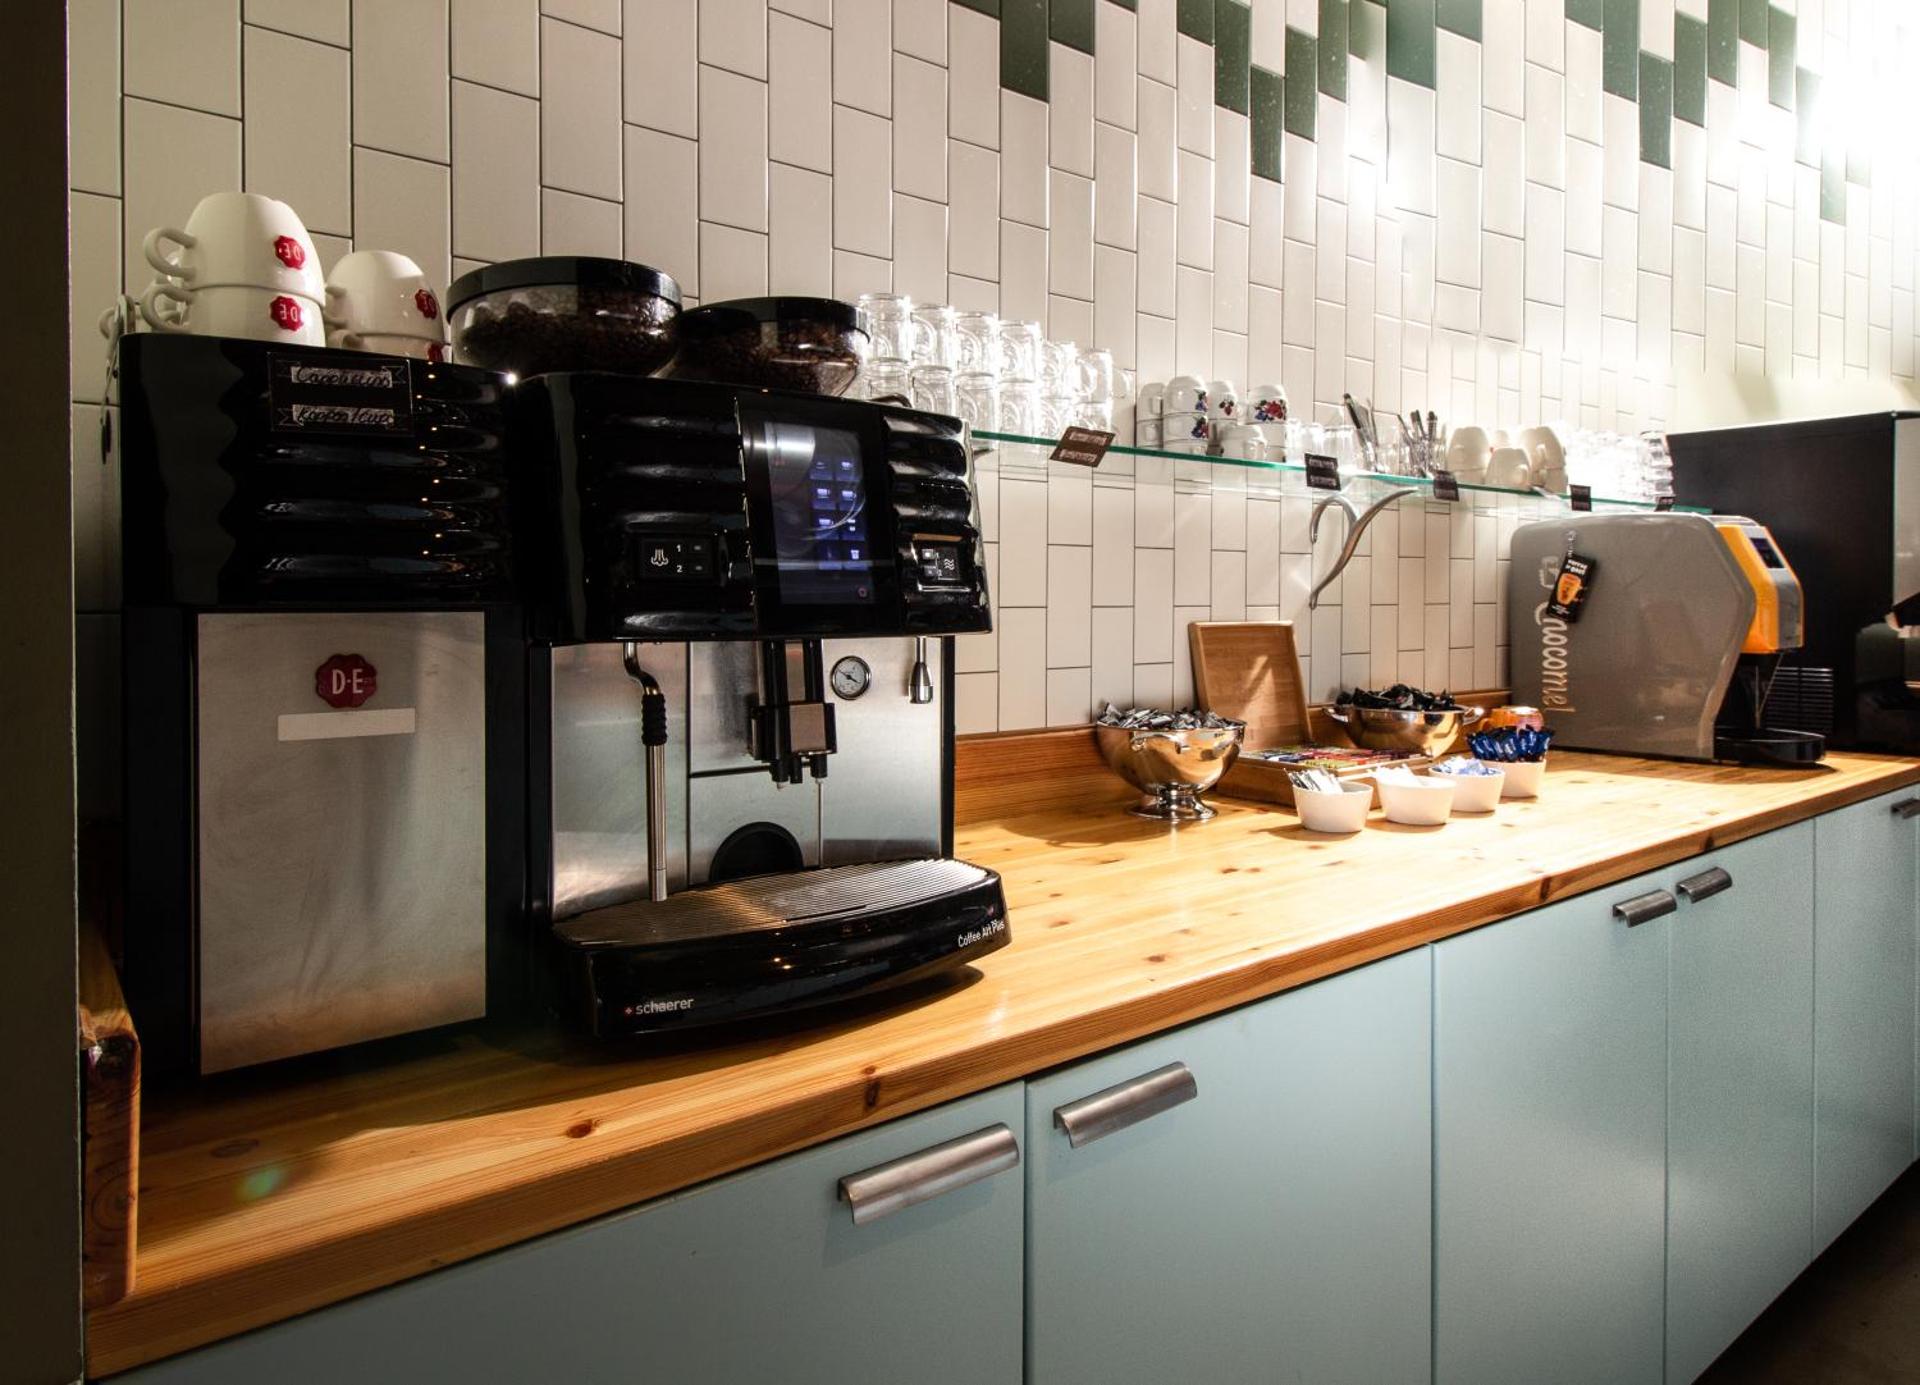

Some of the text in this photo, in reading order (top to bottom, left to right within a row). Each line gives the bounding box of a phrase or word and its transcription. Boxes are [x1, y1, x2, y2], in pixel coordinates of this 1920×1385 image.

[676, 565, 683, 573] 2
[958, 932, 981, 947] Coffee
[635, 999, 694, 1015] schaerer
